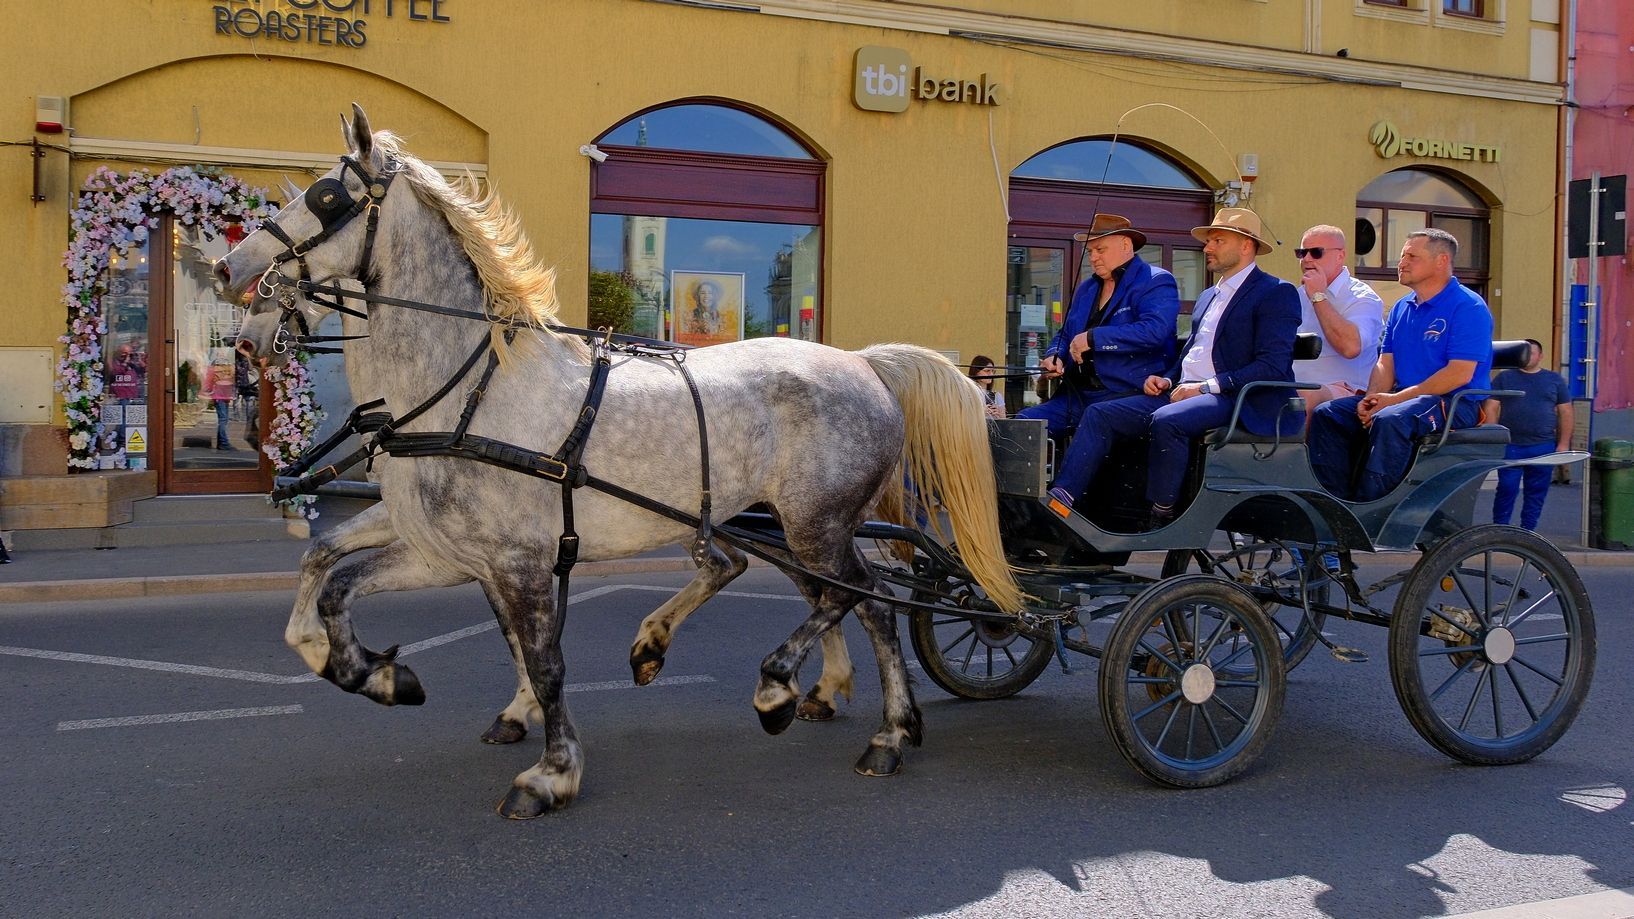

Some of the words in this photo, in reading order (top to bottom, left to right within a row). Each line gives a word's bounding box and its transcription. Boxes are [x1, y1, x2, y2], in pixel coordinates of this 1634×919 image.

[214, 6, 367, 48] ROASTERS
[862, 64, 907, 97] tbi
[914, 65, 1001, 106] bank
[1400, 138, 1501, 163] FORNETTI
